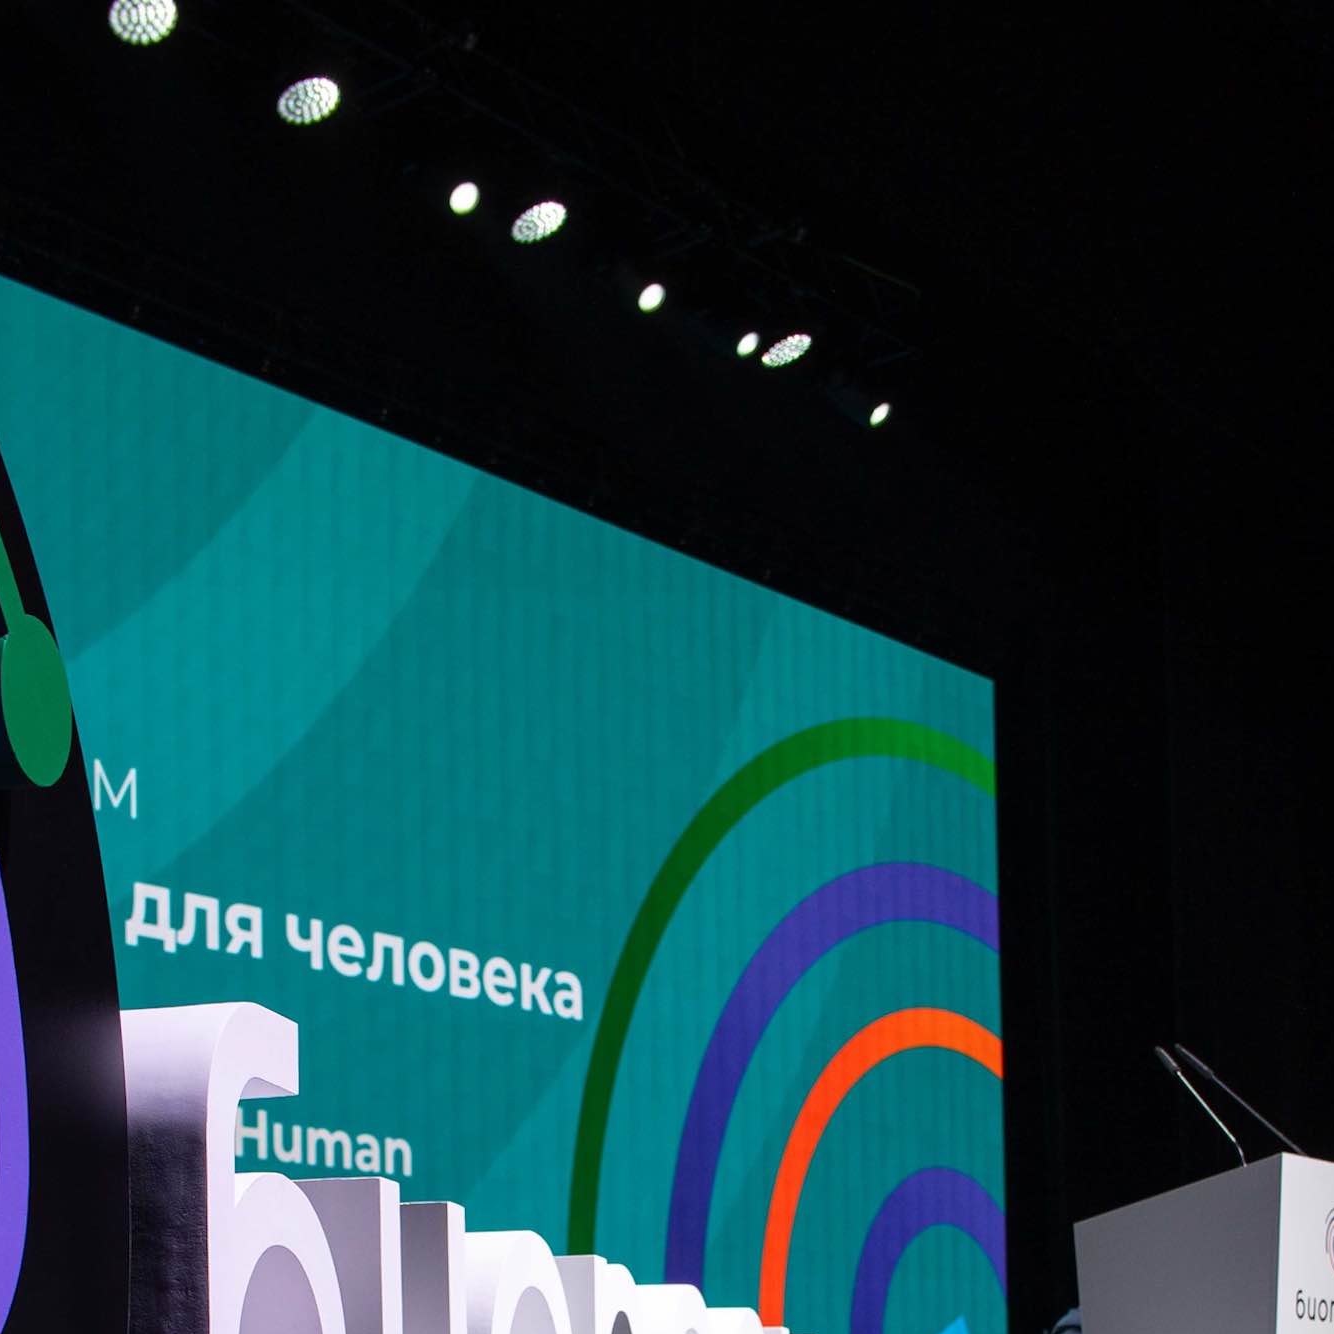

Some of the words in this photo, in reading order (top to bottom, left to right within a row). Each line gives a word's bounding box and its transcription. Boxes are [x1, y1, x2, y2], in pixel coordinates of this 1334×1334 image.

[124, 881, 264, 959] для
[285, 912, 584, 1021] человека
[236, 1105, 413, 1177] Human
